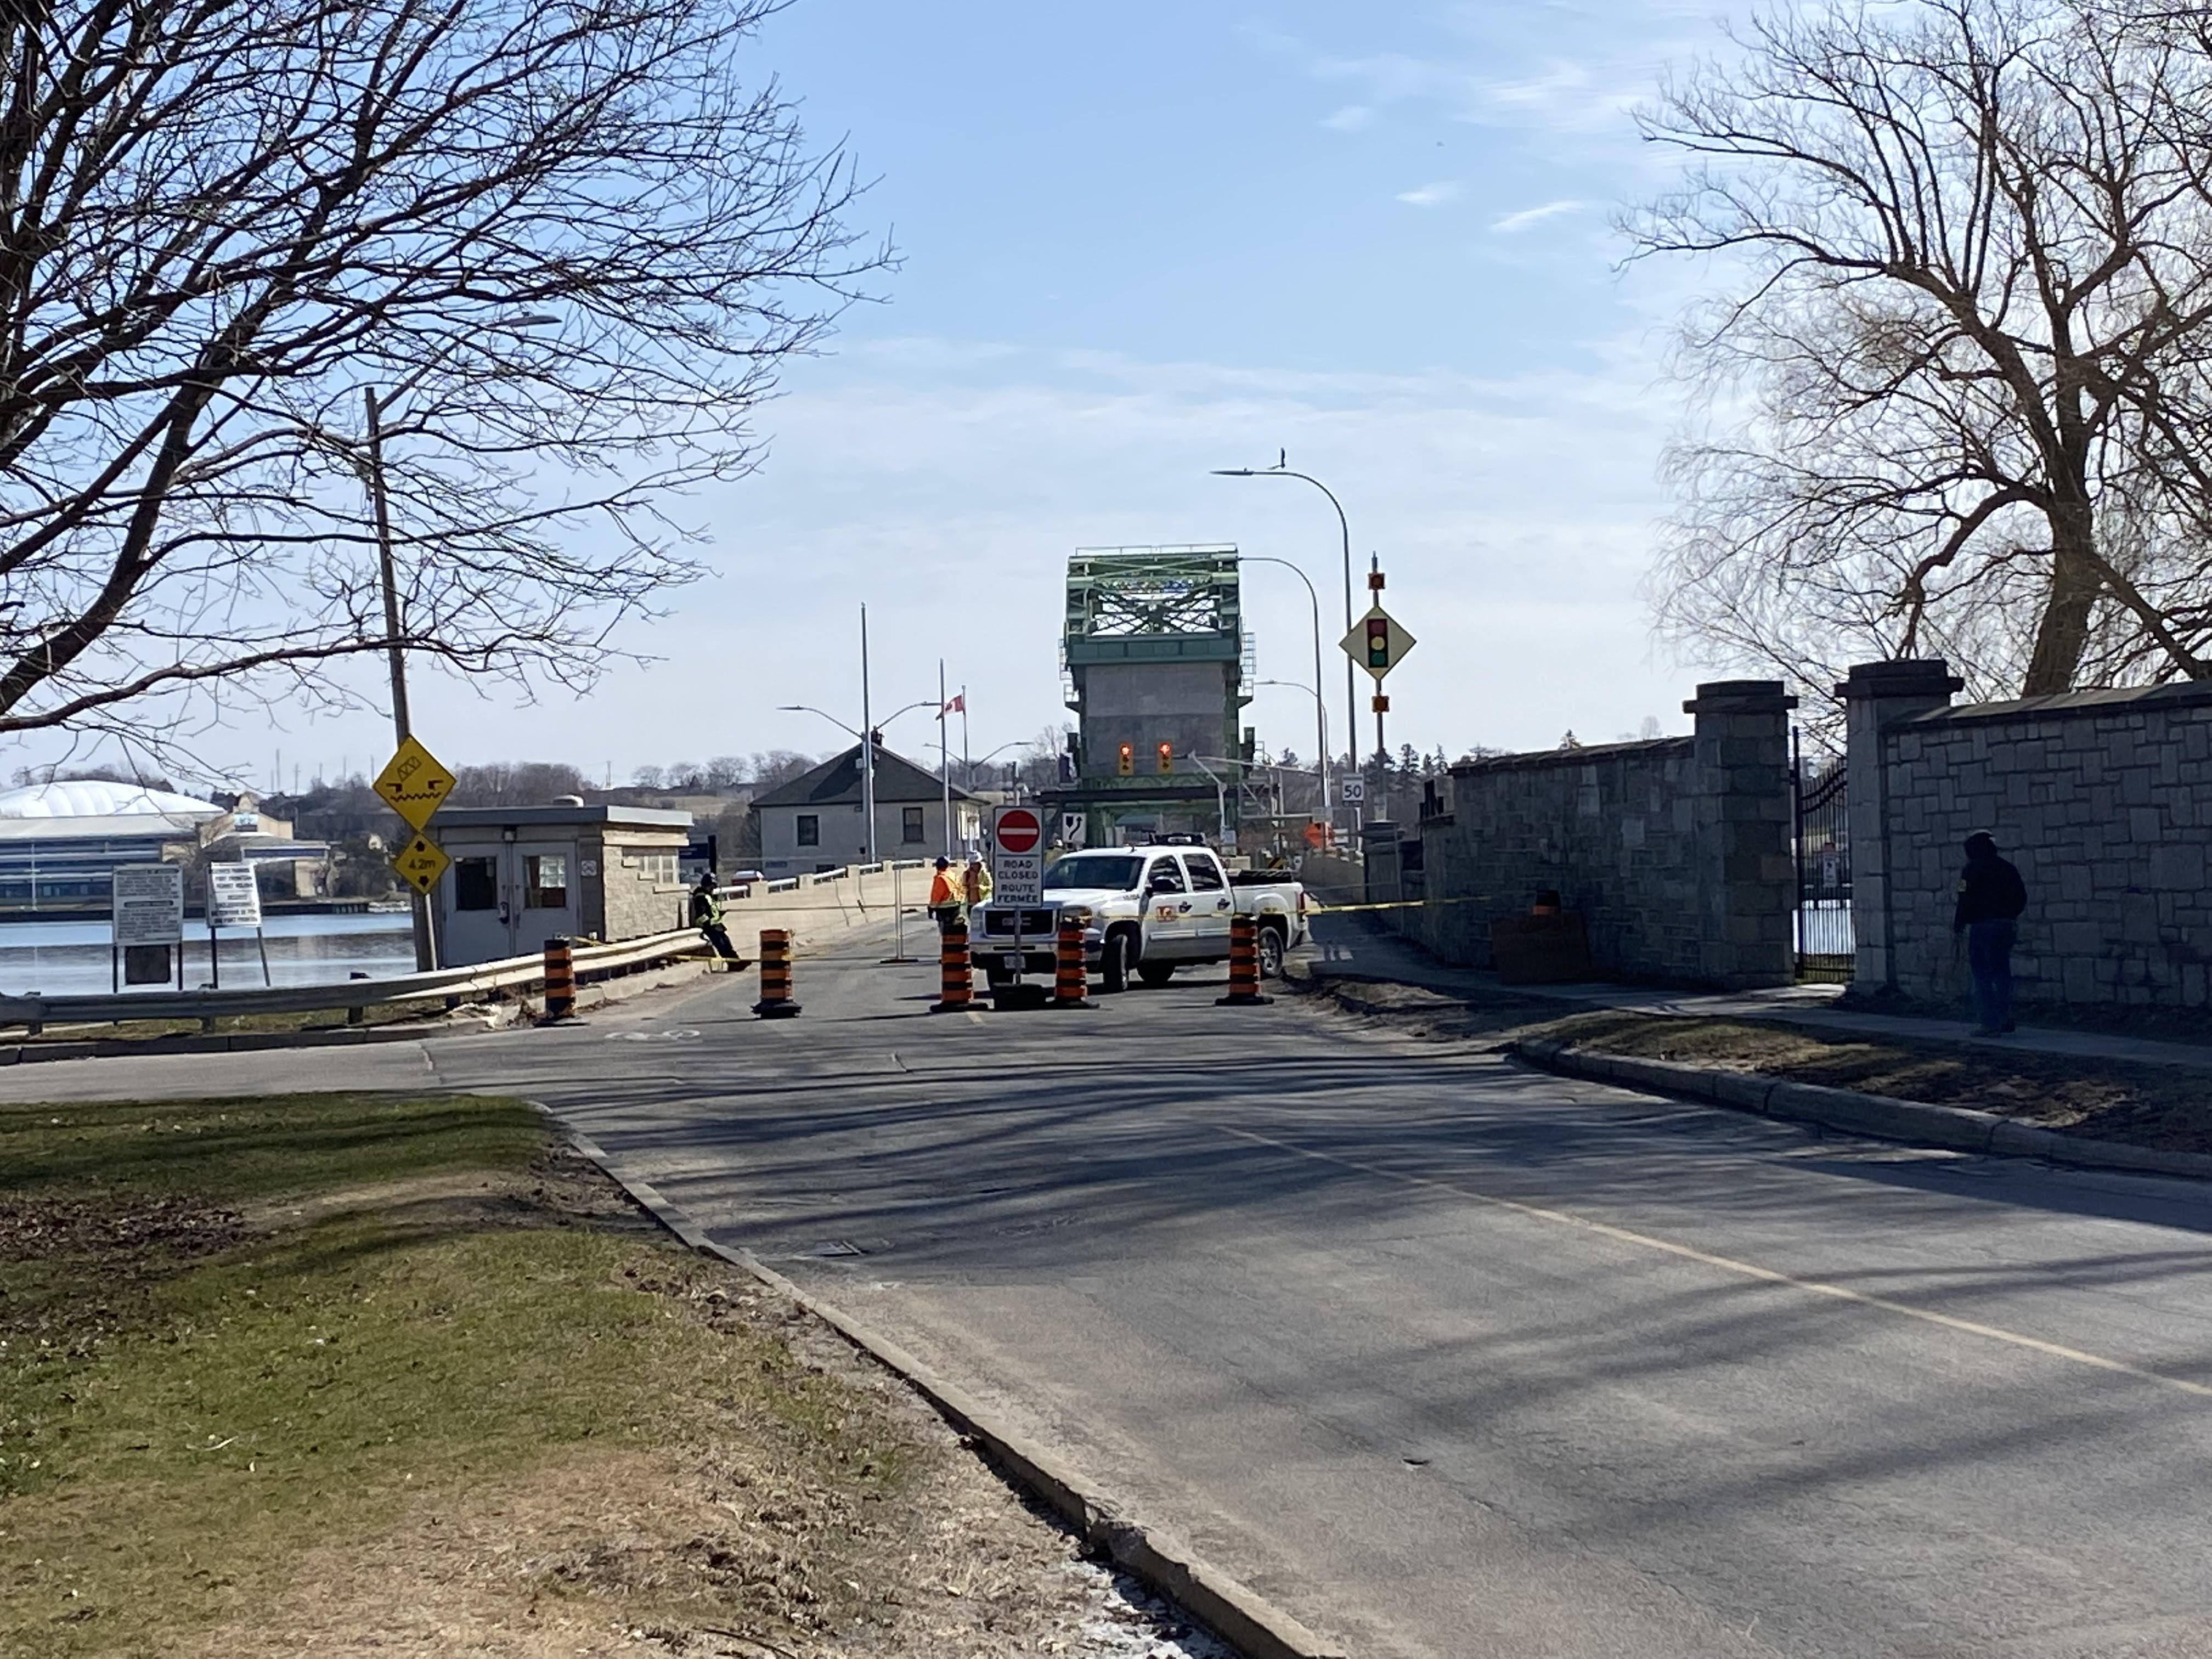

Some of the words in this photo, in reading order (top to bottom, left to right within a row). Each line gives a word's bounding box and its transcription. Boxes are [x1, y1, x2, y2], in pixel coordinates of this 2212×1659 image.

[1344, 785, 1362, 798] 50
[1003, 860, 1033, 869] ROAD
[998, 871, 1039, 880] CLOSED
[1001, 884, 1035, 893] ROUTE
